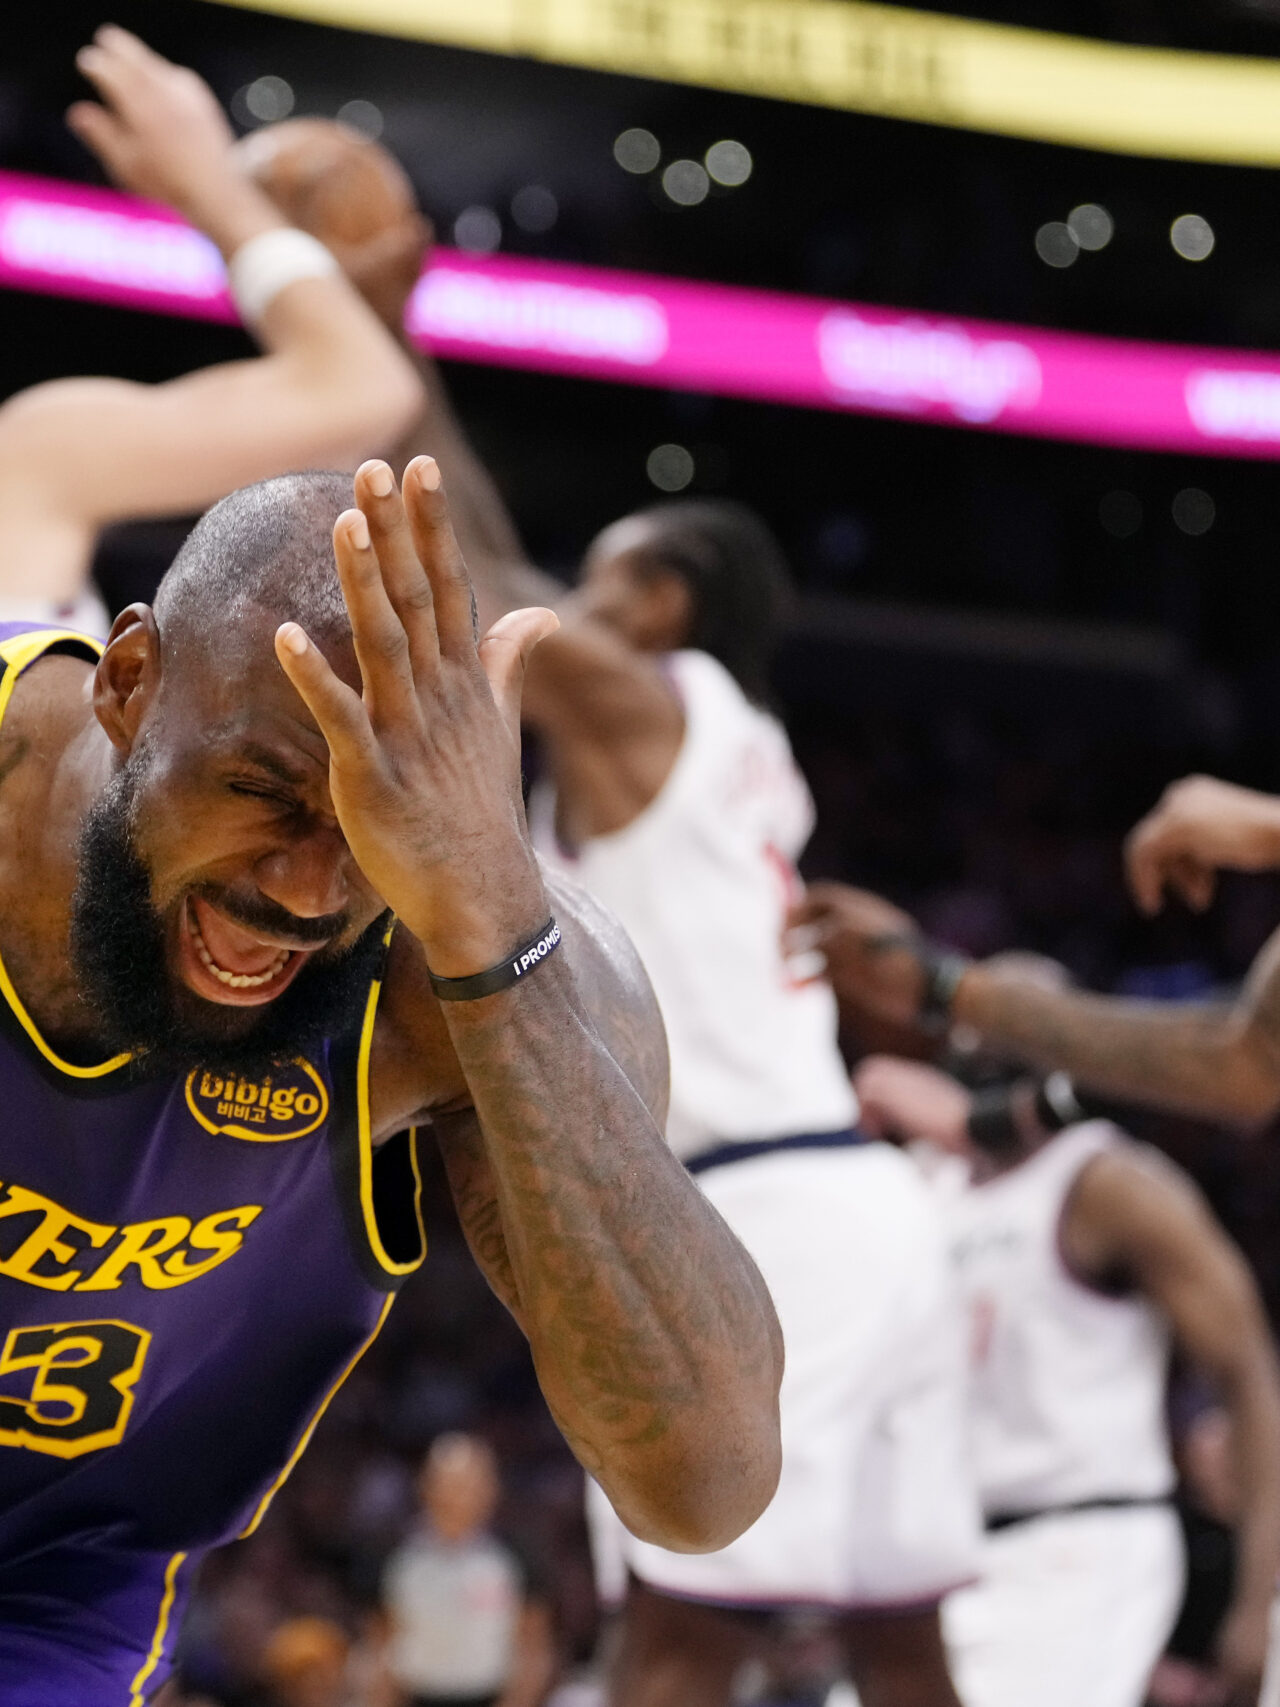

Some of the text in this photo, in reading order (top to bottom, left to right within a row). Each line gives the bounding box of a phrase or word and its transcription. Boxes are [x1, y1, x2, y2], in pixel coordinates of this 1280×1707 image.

[513, 925, 561, 976] I PROMIS
[200, 1071, 319, 1120] bibigo
[217, 1102, 267, 1122] 비비고
